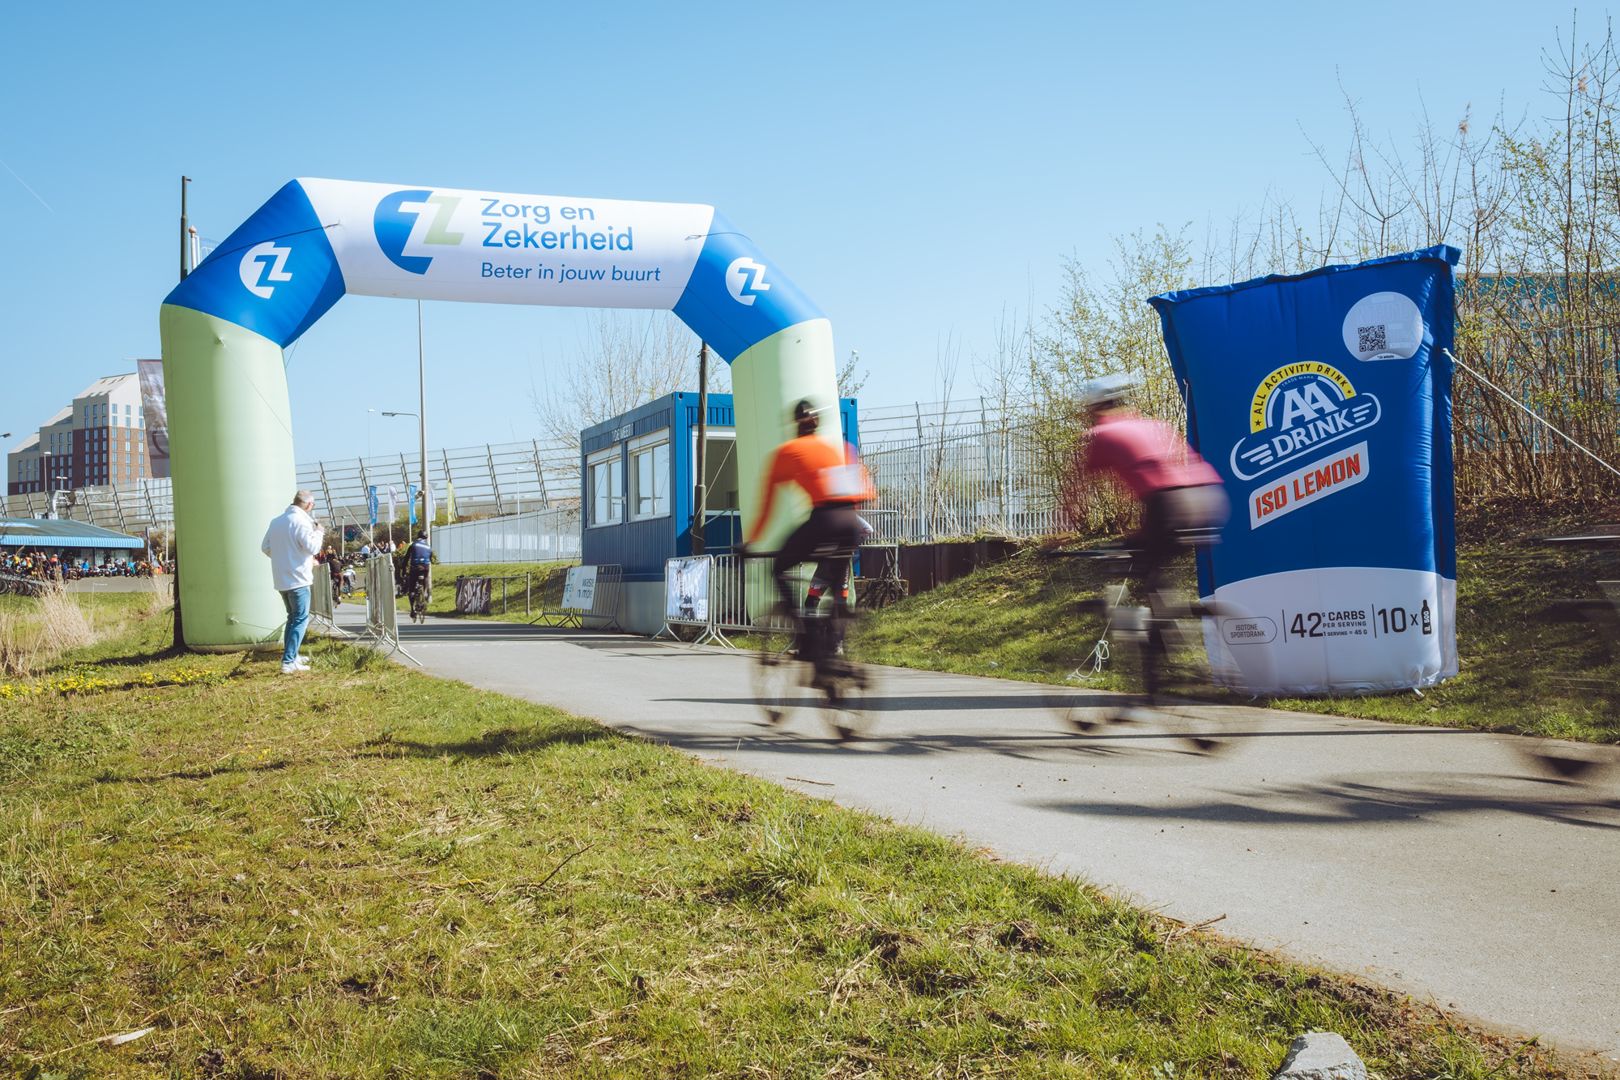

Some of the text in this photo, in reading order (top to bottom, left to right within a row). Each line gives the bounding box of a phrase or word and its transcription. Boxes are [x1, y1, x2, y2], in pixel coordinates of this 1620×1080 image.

[480, 198, 595, 225] Zorg en
[482, 221, 633, 251] Zekerheid
[481, 262, 661, 284] Beter in jouw buurt
[1253, 363, 1349, 415] ALL ACTIVITY DRINK
[1280, 381, 1340, 432] AA
[1271, 408, 1355, 458] DRINK
[1255, 453, 1361, 519] ISO LEMON
[1235, 623, 1258, 631] ISOTONE
[1328, 610, 1366, 621] CARBS
[1337, 620, 1367, 628] SERVING
[1378, 607, 1407, 634] 10
[1230, 630, 1266, 639] SPORTDRANK
